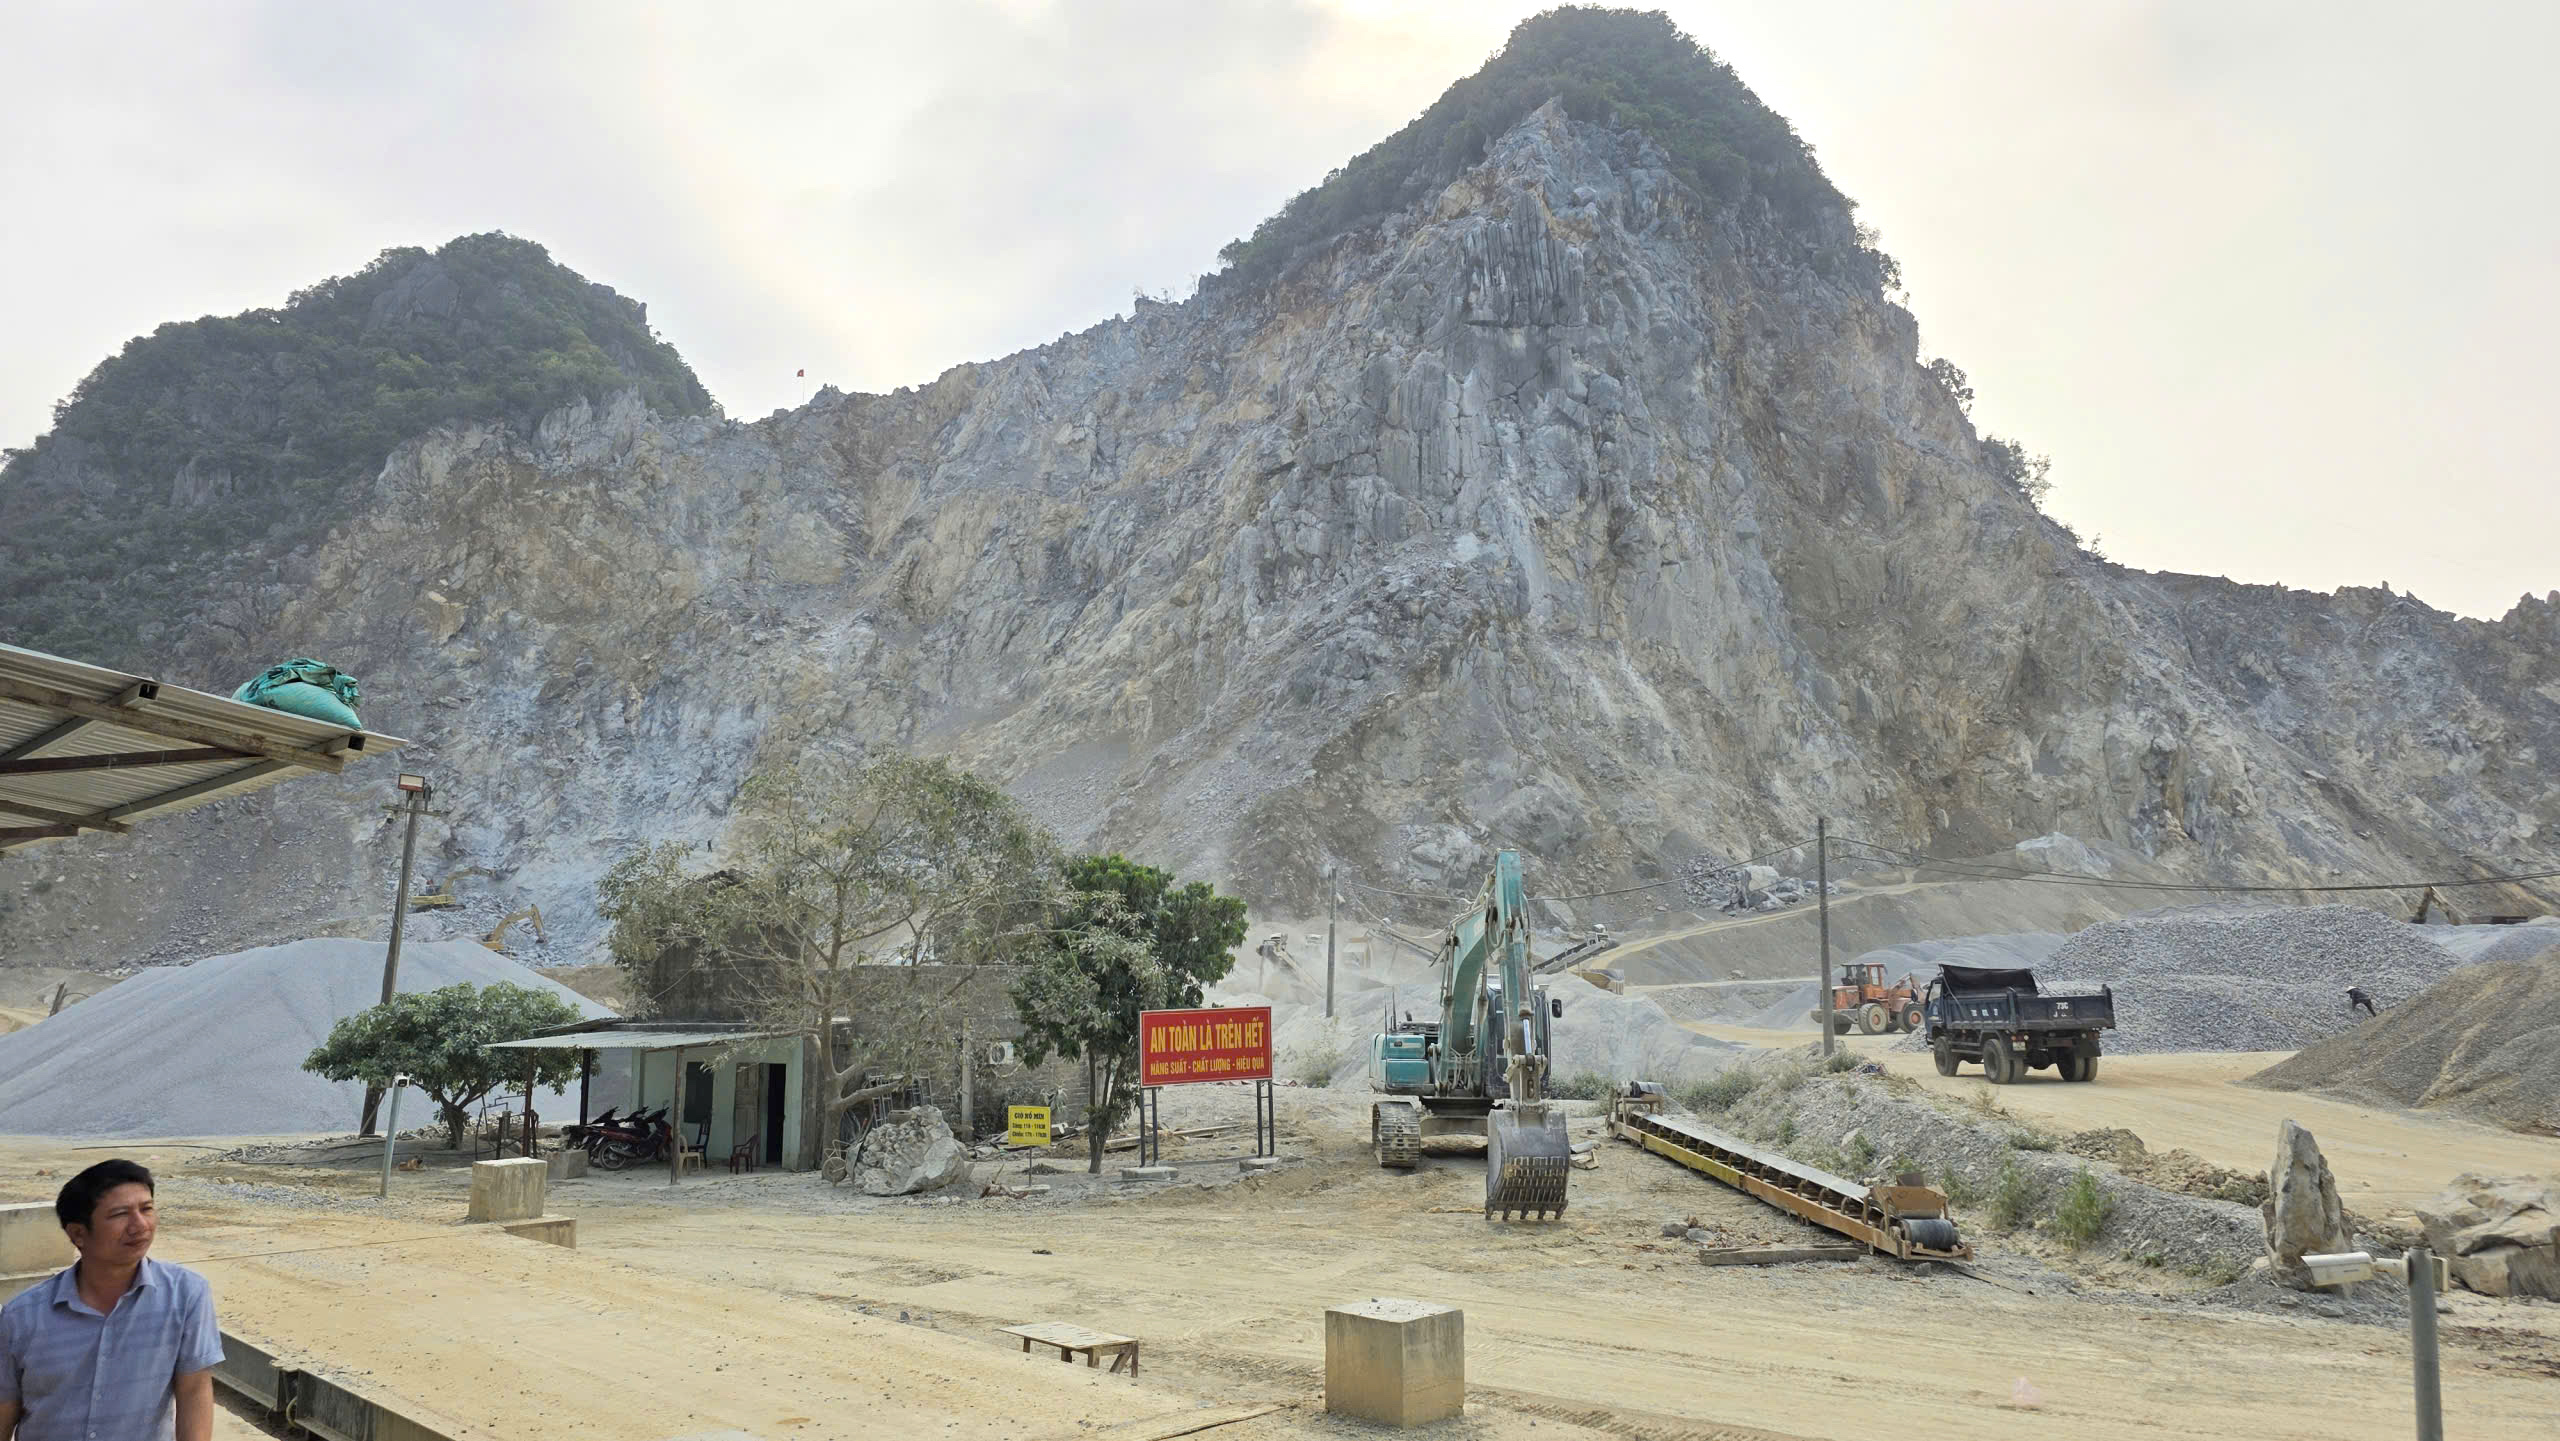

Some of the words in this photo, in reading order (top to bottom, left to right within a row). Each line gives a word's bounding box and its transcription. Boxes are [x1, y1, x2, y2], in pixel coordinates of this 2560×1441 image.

[1150, 1026, 1166, 1053] AN
[1169, 1019, 1197, 1053] TOÀN
[1199, 1018, 1213, 1051] LÀ
[1215, 1017, 1242, 1050] TRÊN
[1244, 1016, 1264, 1048] HẾT
[1192, 1056, 1209, 1073] CHẤT
[1210, 1057, 1231, 1074] LƯỢNG
